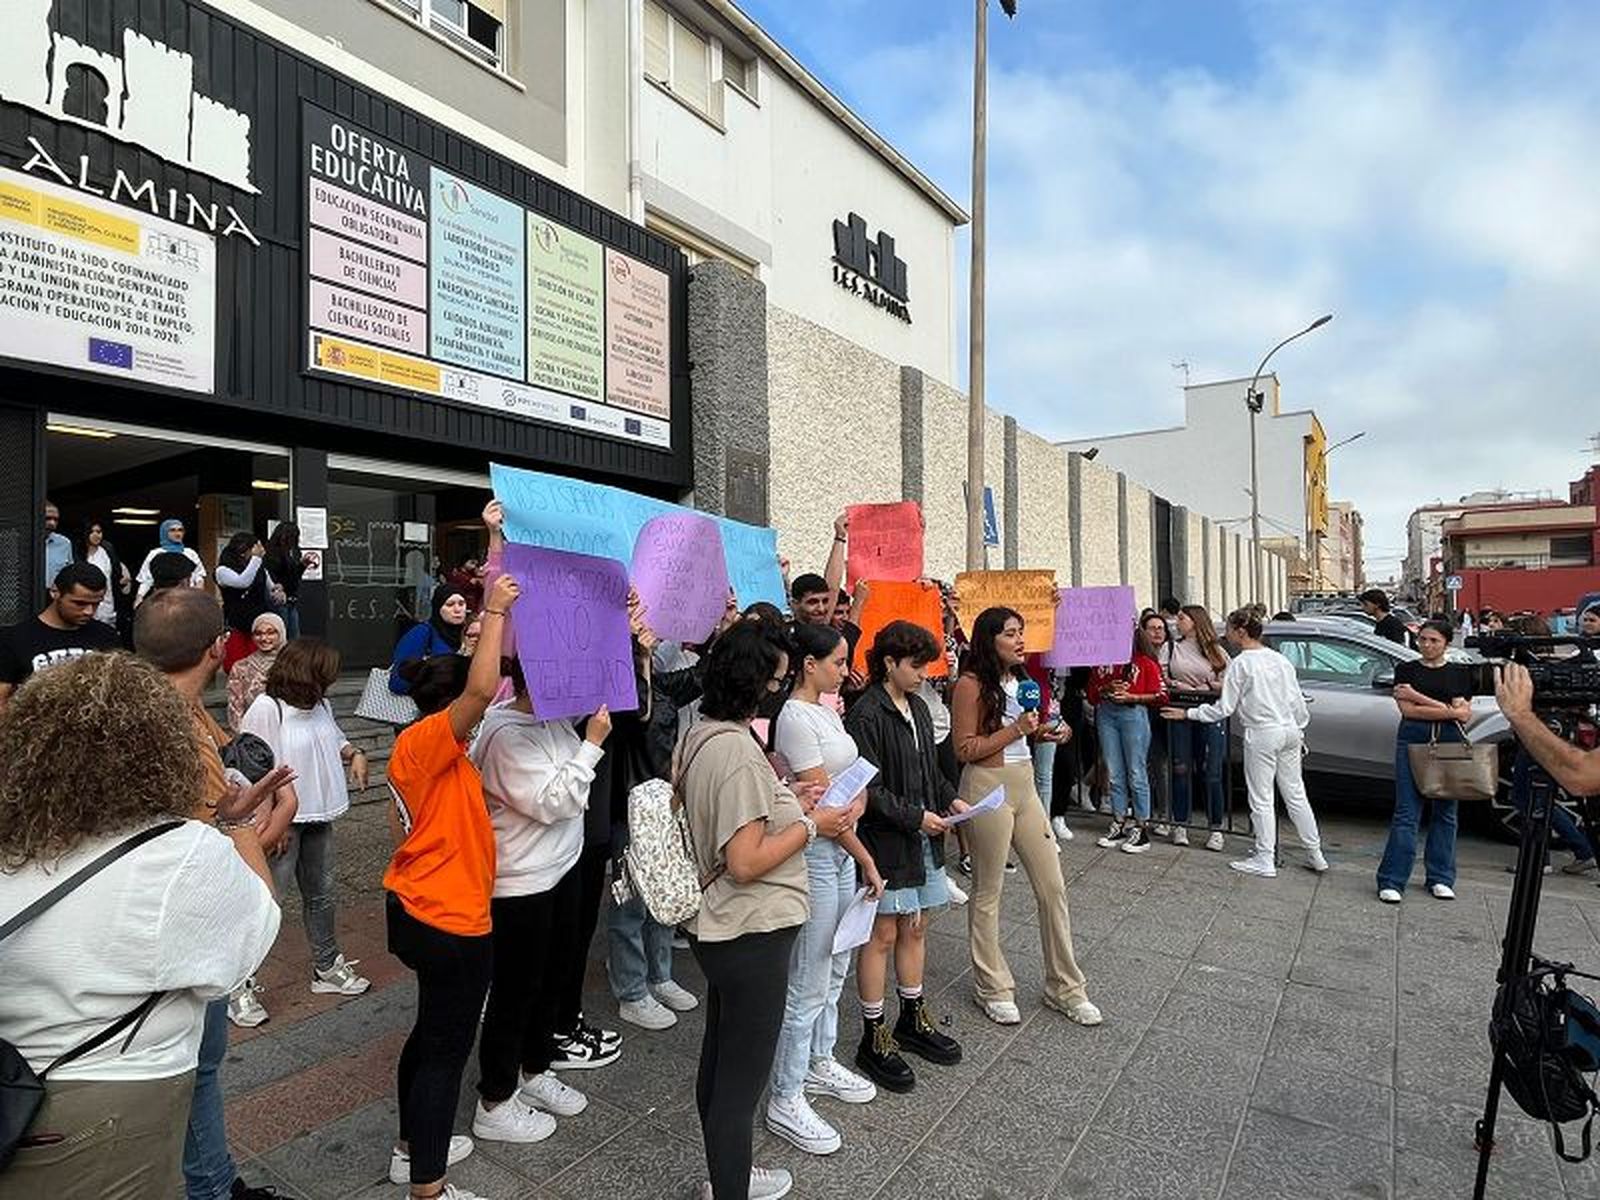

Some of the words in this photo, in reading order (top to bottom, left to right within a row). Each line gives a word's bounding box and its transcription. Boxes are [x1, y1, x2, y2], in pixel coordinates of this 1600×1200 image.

[331, 123, 410, 181] OFERTA
[22, 136, 261, 247] ALMINA
[311, 143, 426, 216] EDUCATIVA
[61, 247, 77, 261] HA
[81, 252, 108, 269] SIDO
[111, 261, 189, 291] COFINANCIADO
[339, 245, 400, 278] BACHILLERATO
[8, 263, 17, 276] Y
[21, 267, 37, 281] LA
[141, 298, 149, 309] A
[117, 276, 163, 299] GENERAL
[168, 291, 185, 305] DEL
[343, 265, 355, 279] DE
[358, 269, 397, 293] CIENCIAS
[44, 303, 51, 315] Y
[47, 289, 111, 313] OPERATIVO
[136, 309, 149, 323] DE
[331, 293, 394, 323] BACHILLERATO
[397, 312, 408, 327] DE
[327, 309, 368, 332] CIENCIAS
[371, 321, 411, 343] SOCIALES
[329, 598, 384, 619] I.E.S.
[547, 604, 592, 651] NO
